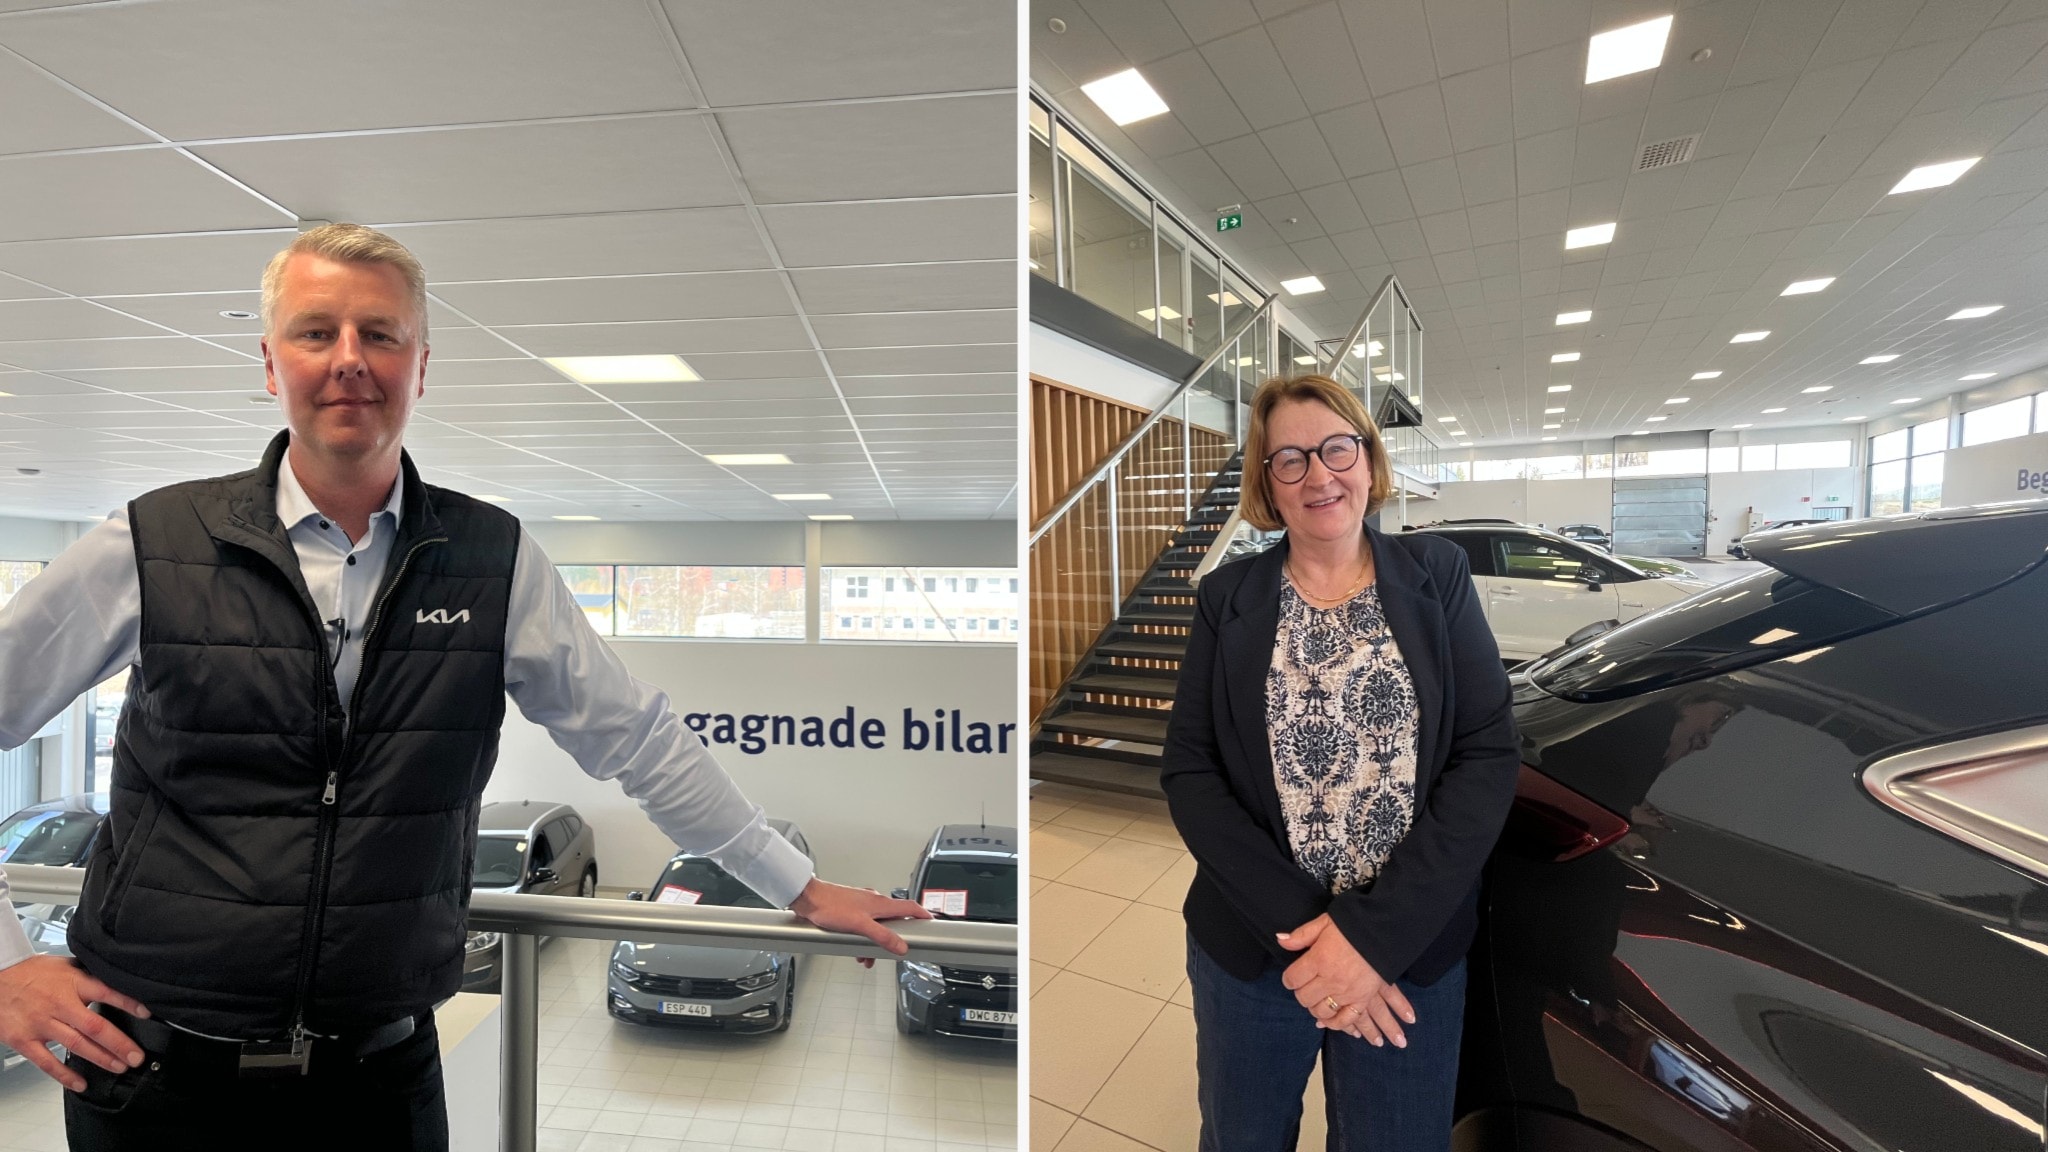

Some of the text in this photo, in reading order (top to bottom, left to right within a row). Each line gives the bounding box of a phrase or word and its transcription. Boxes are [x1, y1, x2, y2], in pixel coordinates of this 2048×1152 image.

[903, 707, 1017, 754] bilar
[666, 1003, 708, 1015] ESP 44D
[969, 1010, 1014, 1023] DWC 87Y
